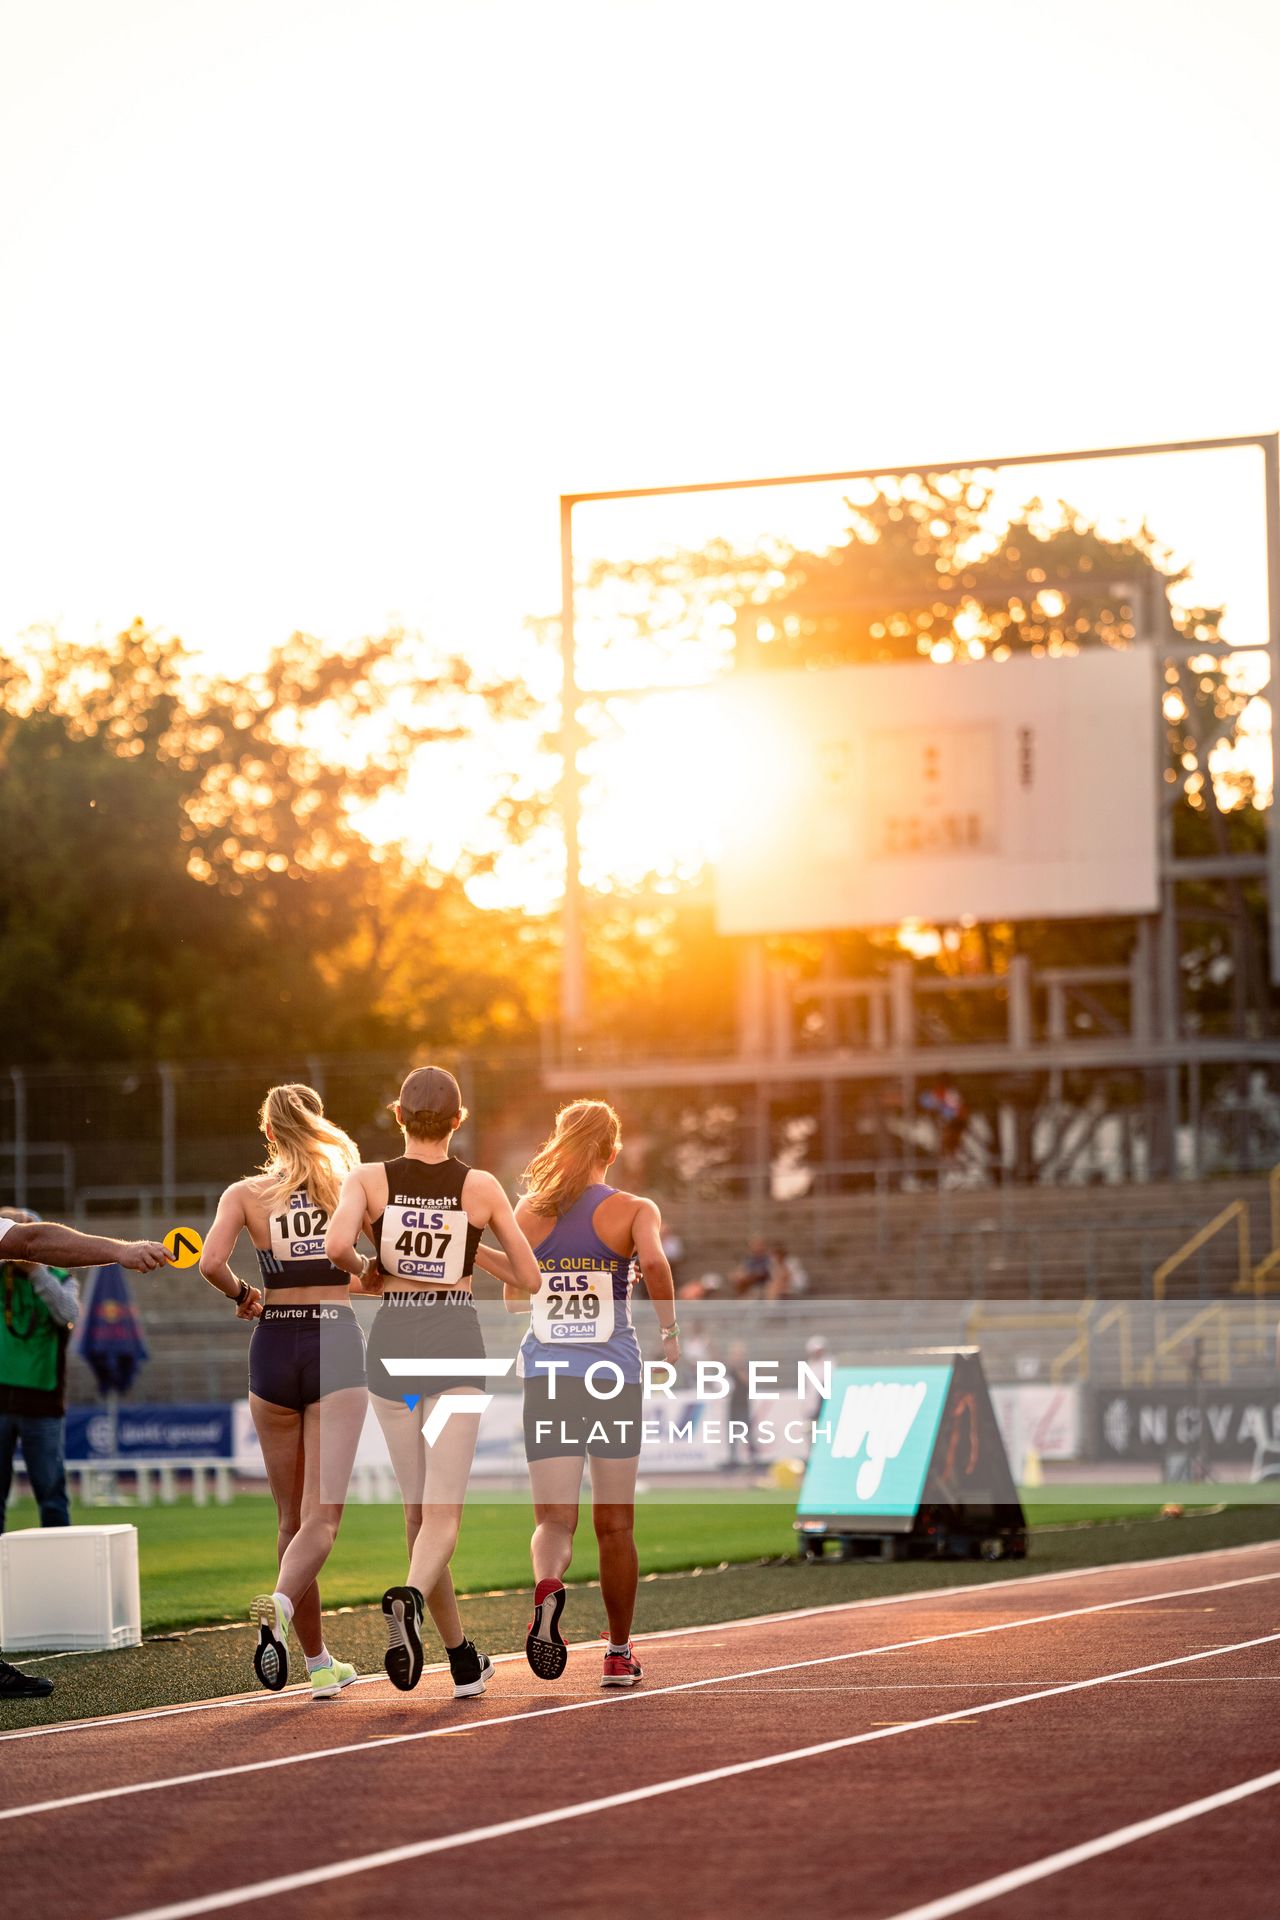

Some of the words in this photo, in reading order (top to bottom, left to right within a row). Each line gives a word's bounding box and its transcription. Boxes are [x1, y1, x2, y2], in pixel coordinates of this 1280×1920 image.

[394, 1194, 458, 1206] Eintracht
[275, 1209, 329, 1239] 102
[309, 1241, 325, 1250] PLA
[394, 1230, 452, 1259] 407
[417, 1262, 443, 1273] PLAN
[538, 1258, 556, 1271] AC
[560, 1257, 619, 1272] QUELLE
[546, 1293, 600, 1320] 249
[264, 1308, 309, 1320] Erfurter
[312, 1309, 339, 1319] LAC
[569, 1325, 594, 1333] PLAN
